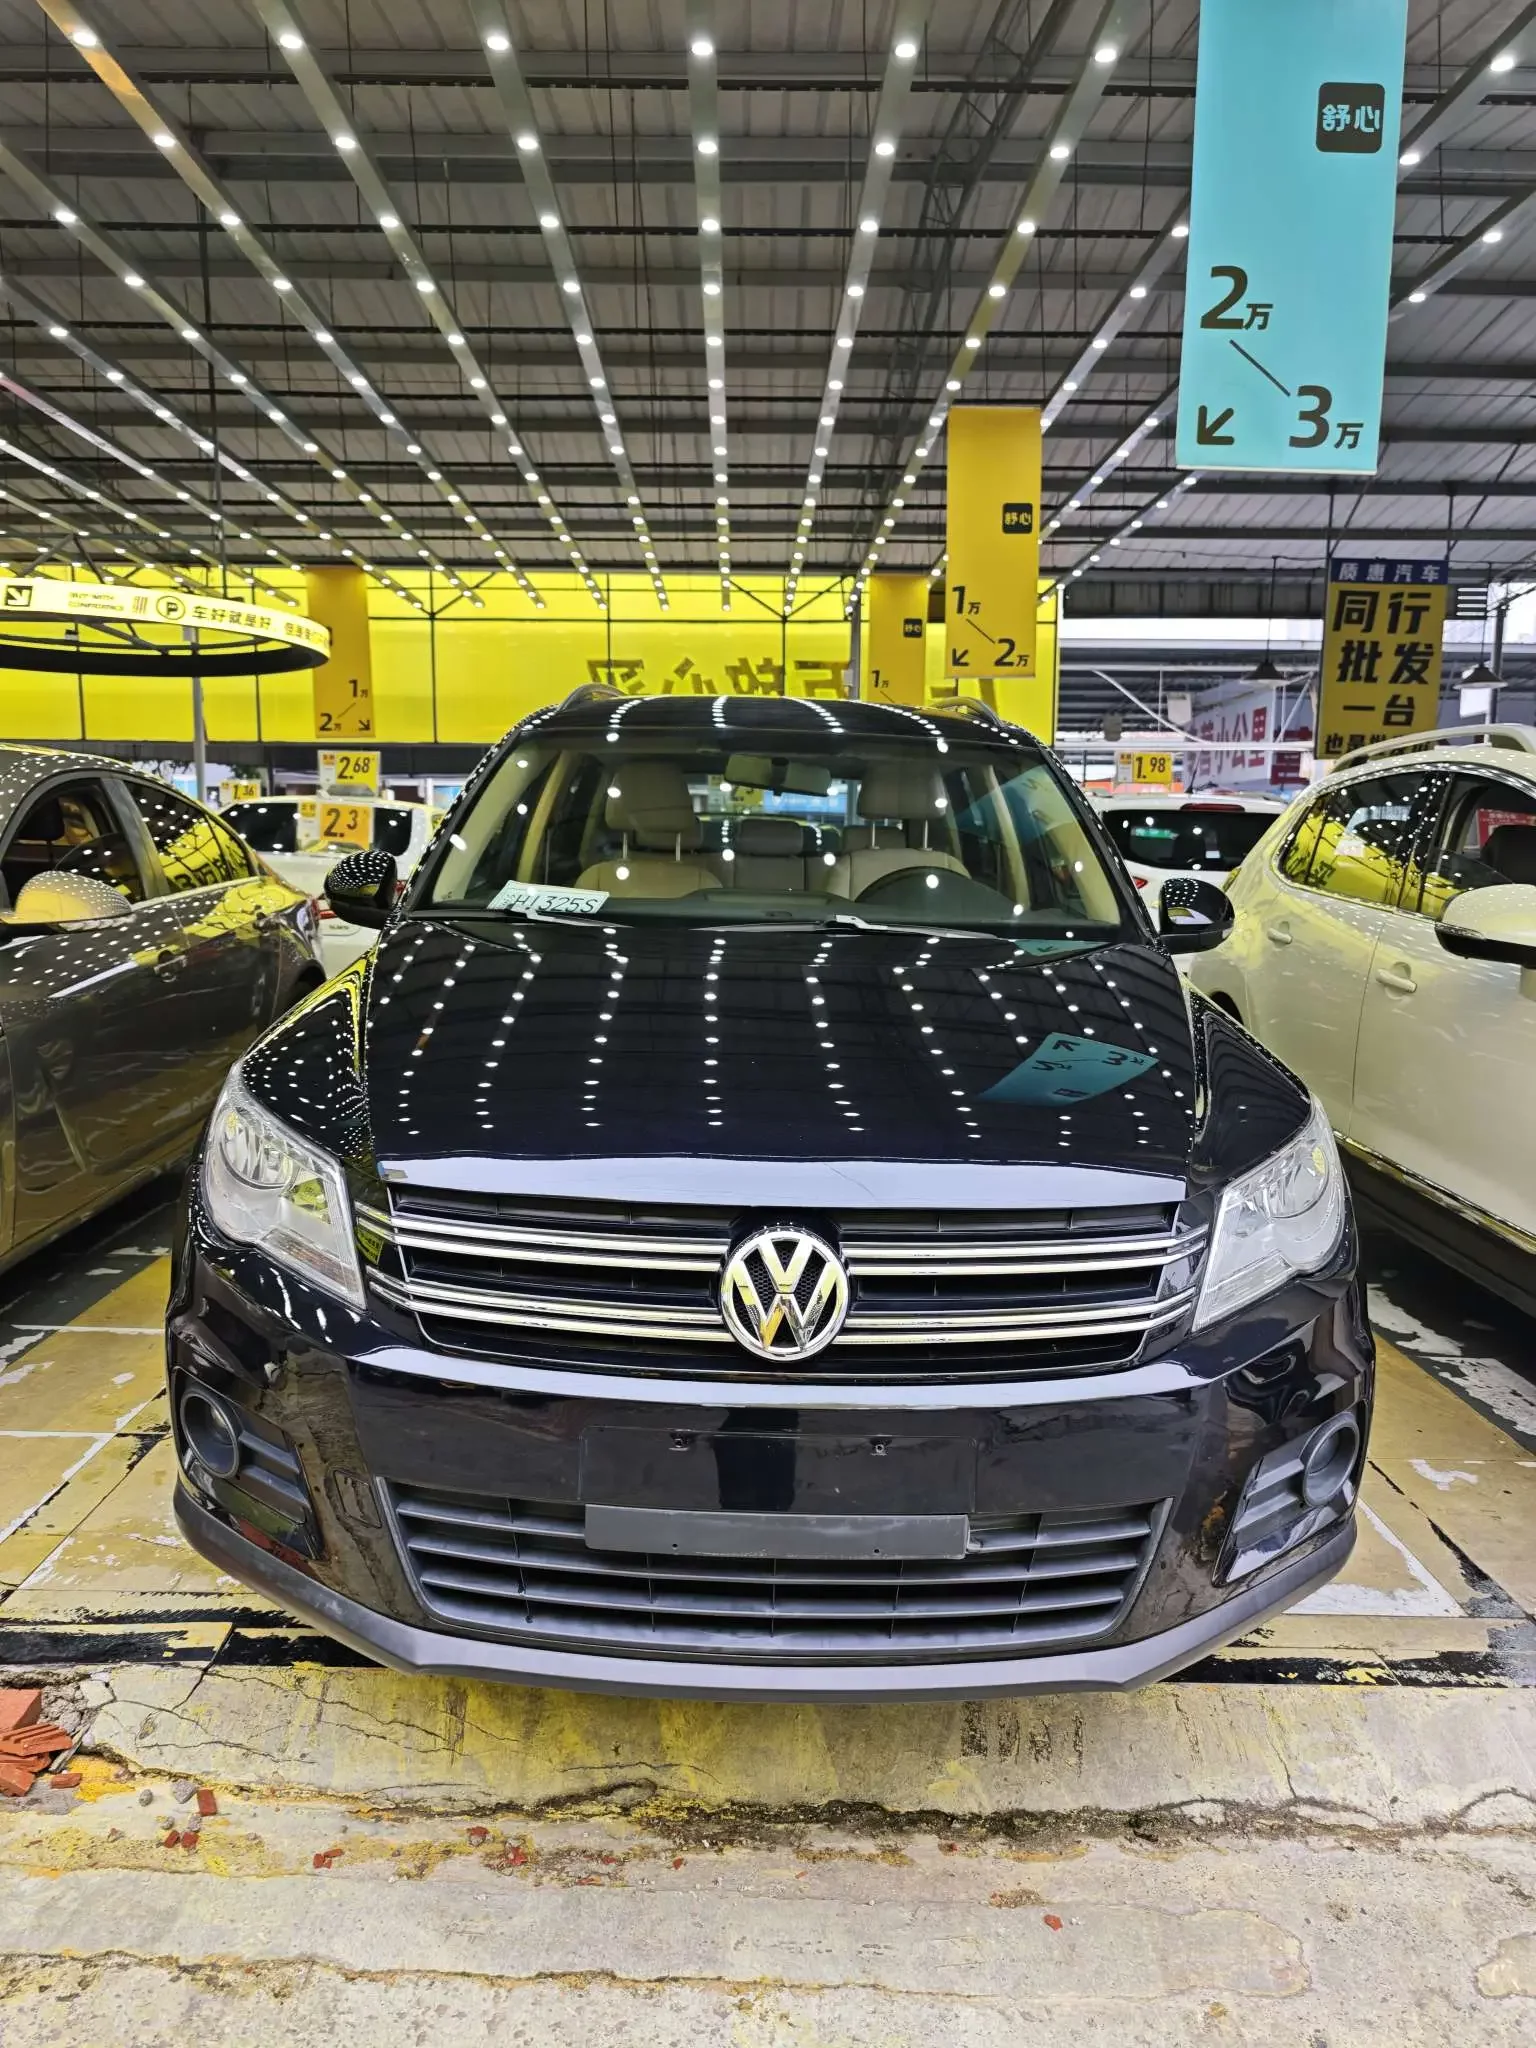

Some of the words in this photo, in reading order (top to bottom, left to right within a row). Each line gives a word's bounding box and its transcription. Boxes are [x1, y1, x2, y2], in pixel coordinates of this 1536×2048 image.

[1321, 104, 1380, 133] 舒心
[1200, 265, 1273, 331] 2万
[1288, 384, 1364, 449] 3万
[952, 585, 981, 615] 1万
[1332, 590, 1432, 635] 同行
[994, 638, 1030, 667] 2万
[1336, 639, 1434, 685] 批发
[1343, 694, 1415, 727] 一台
[337, 756, 370, 780] 2.68
[1136, 756, 1166, 779] 1.98
[324, 808, 358, 838] 2.3
